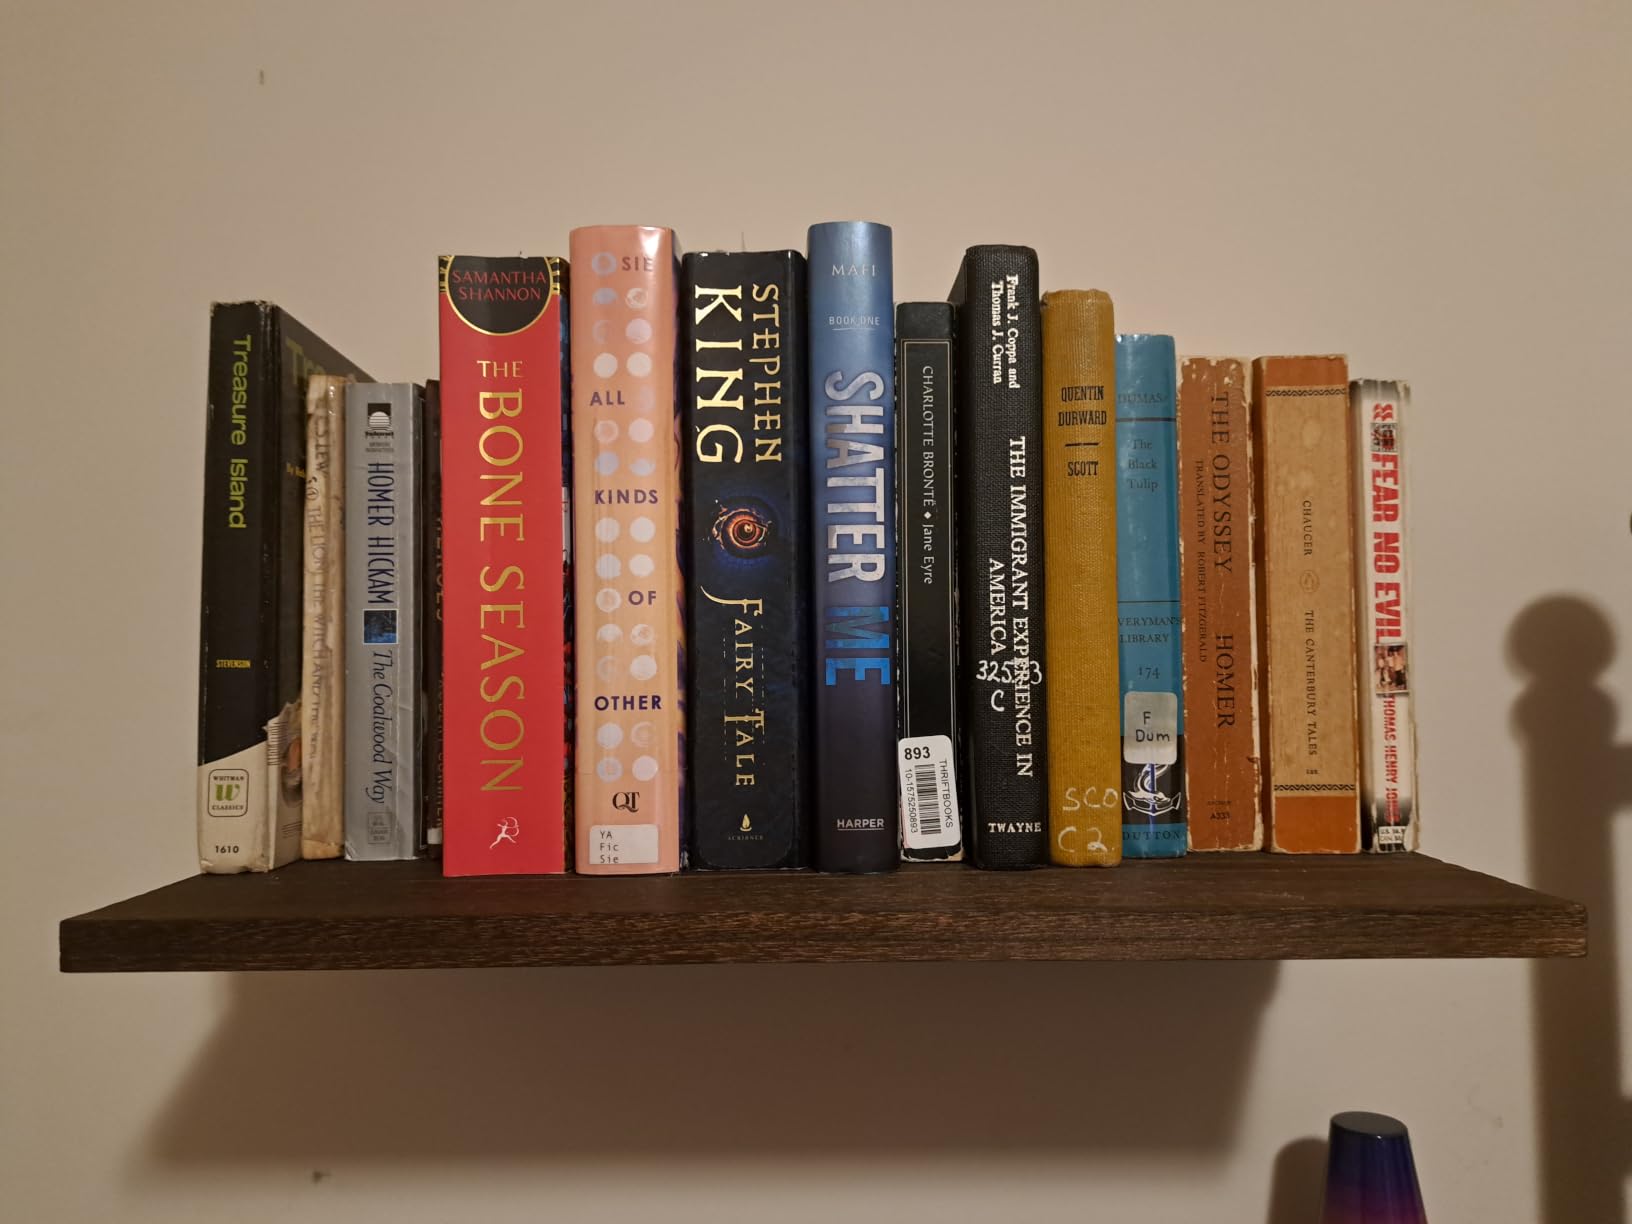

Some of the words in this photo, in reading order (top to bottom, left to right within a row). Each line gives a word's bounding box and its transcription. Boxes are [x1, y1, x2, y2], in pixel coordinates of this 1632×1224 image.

[452, 270, 546, 284] SAMANTHA
[621, 257, 654, 272] SIE
[831, 264, 876, 277] MAFI
[458, 287, 541, 301] SHANNON
[991, 280, 1004, 327] Thomas
[1006, 274, 1019, 311] Frank
[829, 316, 854, 326] BOOK
[855, 316, 880, 326] ONE
[1007, 314, 1018, 324] J.
[1006, 327, 1018, 364] Coppa
[477, 360, 523, 378] THE
[694, 284, 744, 464] KING
[749, 283, 782, 463] STEPHEN
[991, 344, 1004, 384] Curran
[1008, 366, 1020, 389] and
[231, 335, 251, 446] Treasure
[590, 391, 625, 406] ALL
[922, 366, 934, 446] CHARLOTTE
[1061, 385, 1104, 402] QUENTIN
[1058, 410, 1107, 426] DURWARD
[1211, 392, 1230, 444] THE
[1009, 436, 1026, 479] THE
[1132, 439, 1152, 450] The
[479, 389, 524, 543] BONE
[824, 371, 888, 582] SHATTER
[922, 452, 936, 506] BRONTË
[1067, 461, 1099, 477] SCOTT
[1128, 459, 1157, 470] Black
[228, 458, 249, 529] Island
[367, 463, 395, 527] HOMER
[594, 489, 658, 504] KINDS
[1127, 478, 1158, 492] Tulip
[1195, 460, 1206, 528] TRANSLATED
[1371, 453, 1400, 522] FEAR
[1211, 453, 1232, 574] ODYSSEY
[1302, 500, 1312, 556] CHAUCER
[922, 524, 933, 552] Jane
[1010, 485, 1029, 610] IMMIGRANT
[1197, 531, 1207, 545] BY
[1373, 532, 1401, 574] NO
[367, 537, 395, 603] HICKAM
[920, 557, 933, 585] Eyre
[1197, 552, 1208, 593] ROBERT
[628, 590, 657, 605] OF
[989, 558, 1006, 656] AMERICA
[1374, 581, 1402, 644] EVIL
[1120, 633, 1168, 643] LIBRARY
[1198, 596, 1209, 663] FITZGERALD
[1304, 610, 1314, 633] THE
[701, 585, 764, 694] FAIRY
[825, 606, 891, 686] ME
[215, 659, 251, 668] STEVENSON
[373, 650, 393, 680] The
[479, 566, 525, 792] SEASON
[1138, 667, 1160, 679] 174
[1215, 632, 1235, 729] HOMER
[1304, 638, 1316, 718] CANTERBURY
[1013, 618, 1033, 747] EXPERIENCE
[594, 695, 662, 711] OTHER
[991, 689, 1005, 712] C
[1143, 711, 1151, 725] F
[1384, 695, 1398, 741] THOMAS
[372, 683, 393, 763] Coalwood
[1135, 729, 1170, 743] Dum
[1307, 721, 1318, 756] TALES
[724, 708, 765, 786] TALE
[904, 746, 930, 760] 893
[1385, 745, 1399, 784] HENRY
[1016, 753, 1033, 777] IN
[365, 767, 393, 804] Way
[612, 791, 640, 813] QT
[904, 769, 919, 833] 10-1575250893
[938, 760, 954, 828] THRIFTBOOKS
[600, 830, 613, 839] YA
[836, 818, 885, 829] HARPER
[988, 822, 1042, 833] TWAYNE
[1122, 831, 1181, 841] DUTTON
[215, 845, 239, 854] 1610
[600, 842, 619, 851] Fic
[600, 854, 619, 864] Sie
